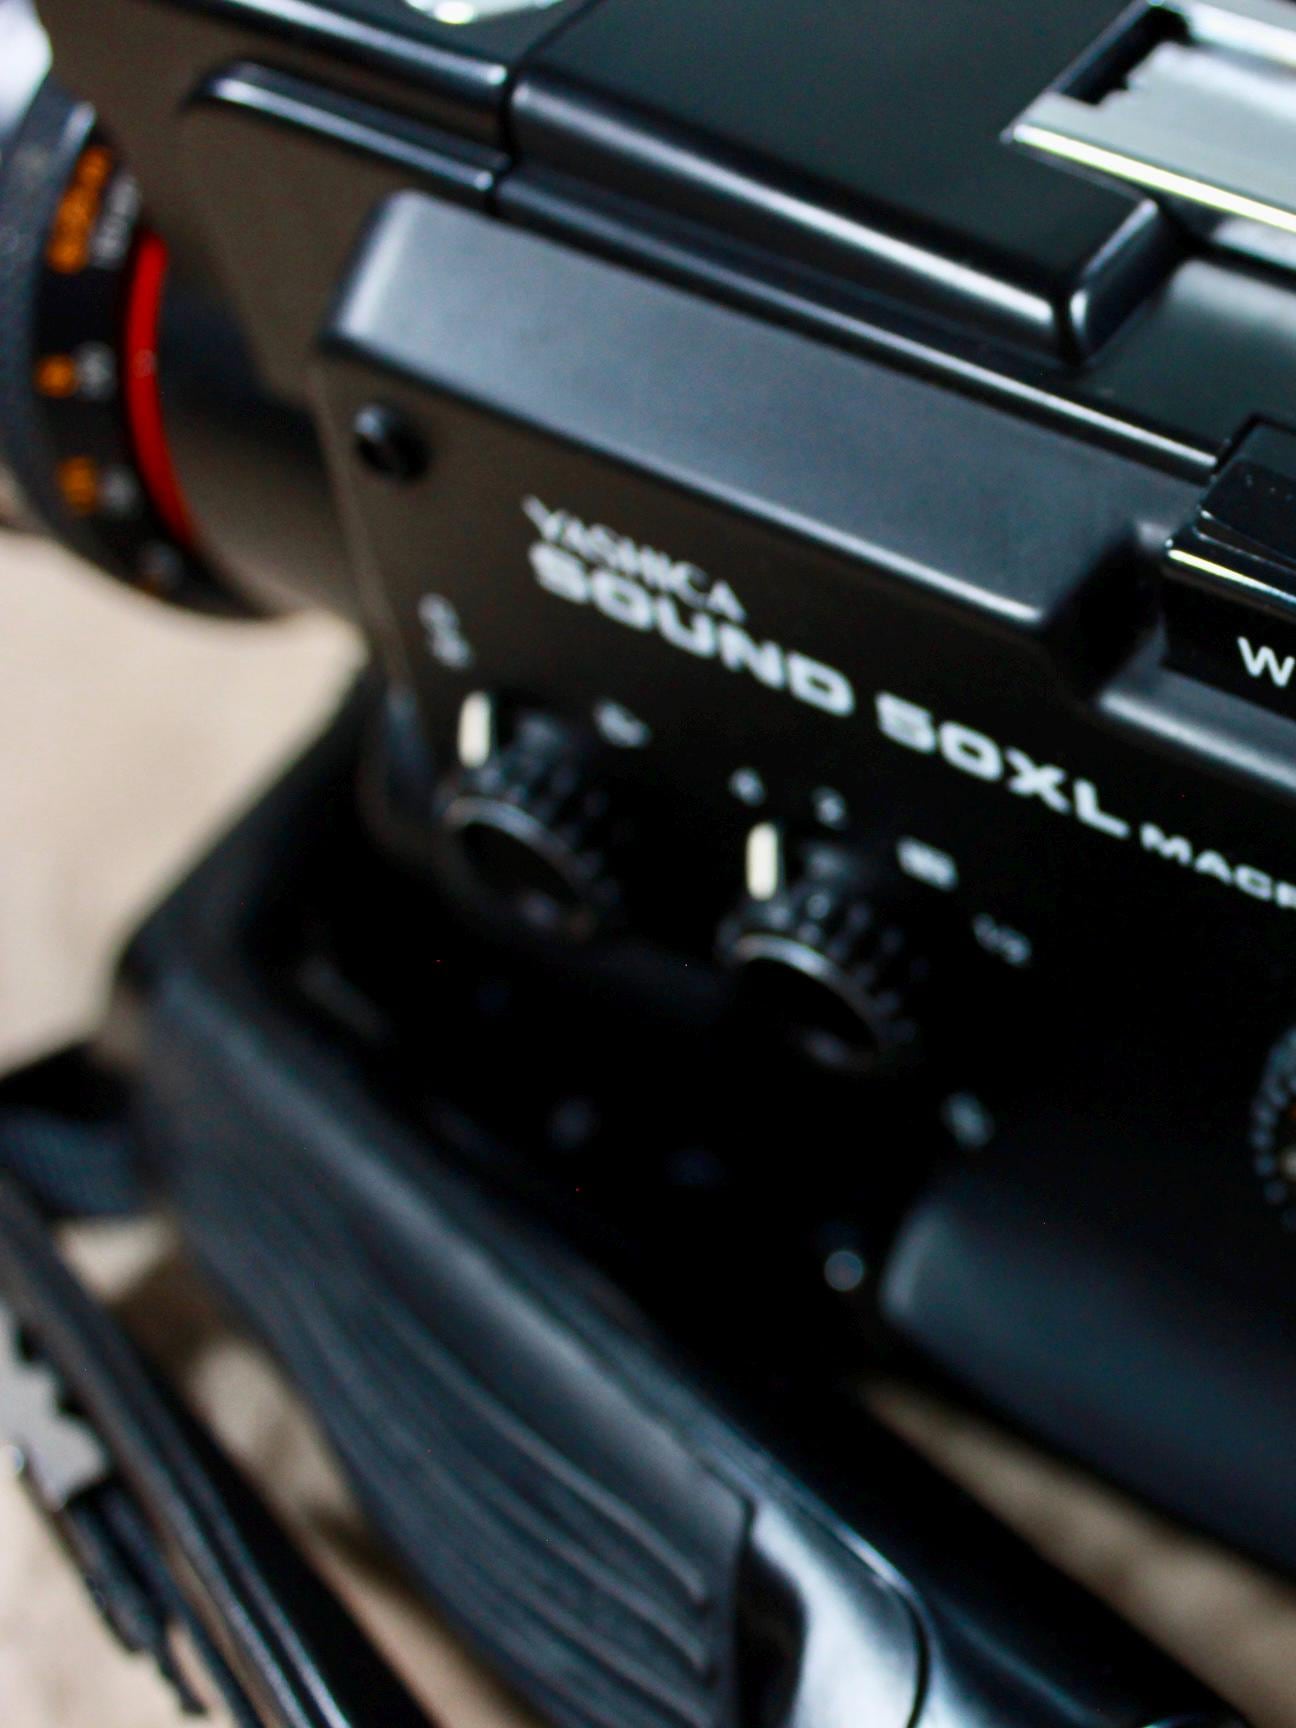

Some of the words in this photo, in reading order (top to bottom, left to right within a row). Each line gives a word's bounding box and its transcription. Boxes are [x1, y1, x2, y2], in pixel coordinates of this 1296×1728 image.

[522, 496, 744, 622] YASHICA
[529, 543, 853, 716] SOUND
[876, 692, 1129, 837] 50XL
